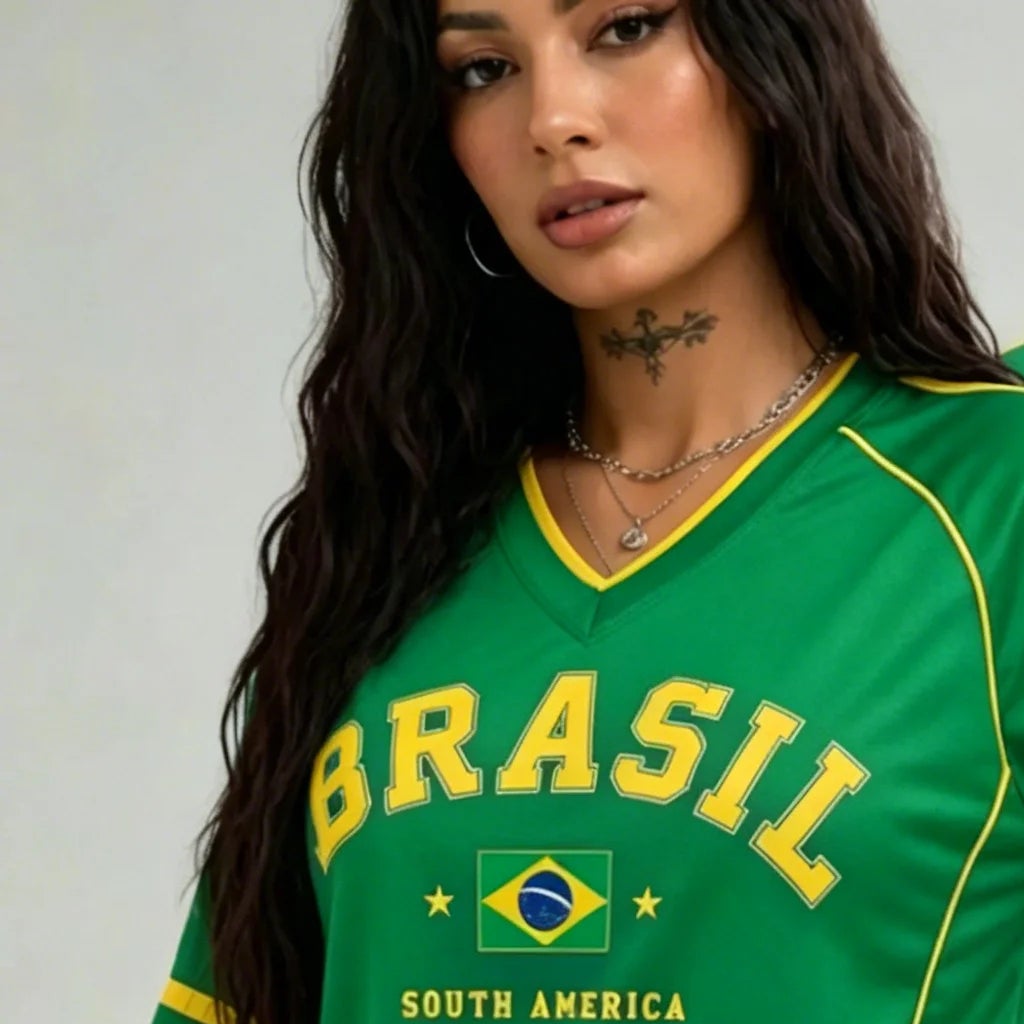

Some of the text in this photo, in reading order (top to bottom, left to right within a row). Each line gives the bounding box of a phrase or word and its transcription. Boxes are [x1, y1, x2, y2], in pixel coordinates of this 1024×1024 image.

[309, 670, 871, 909] BRASIL
[400, 989, 686, 1022] SOUTH AMERICA
